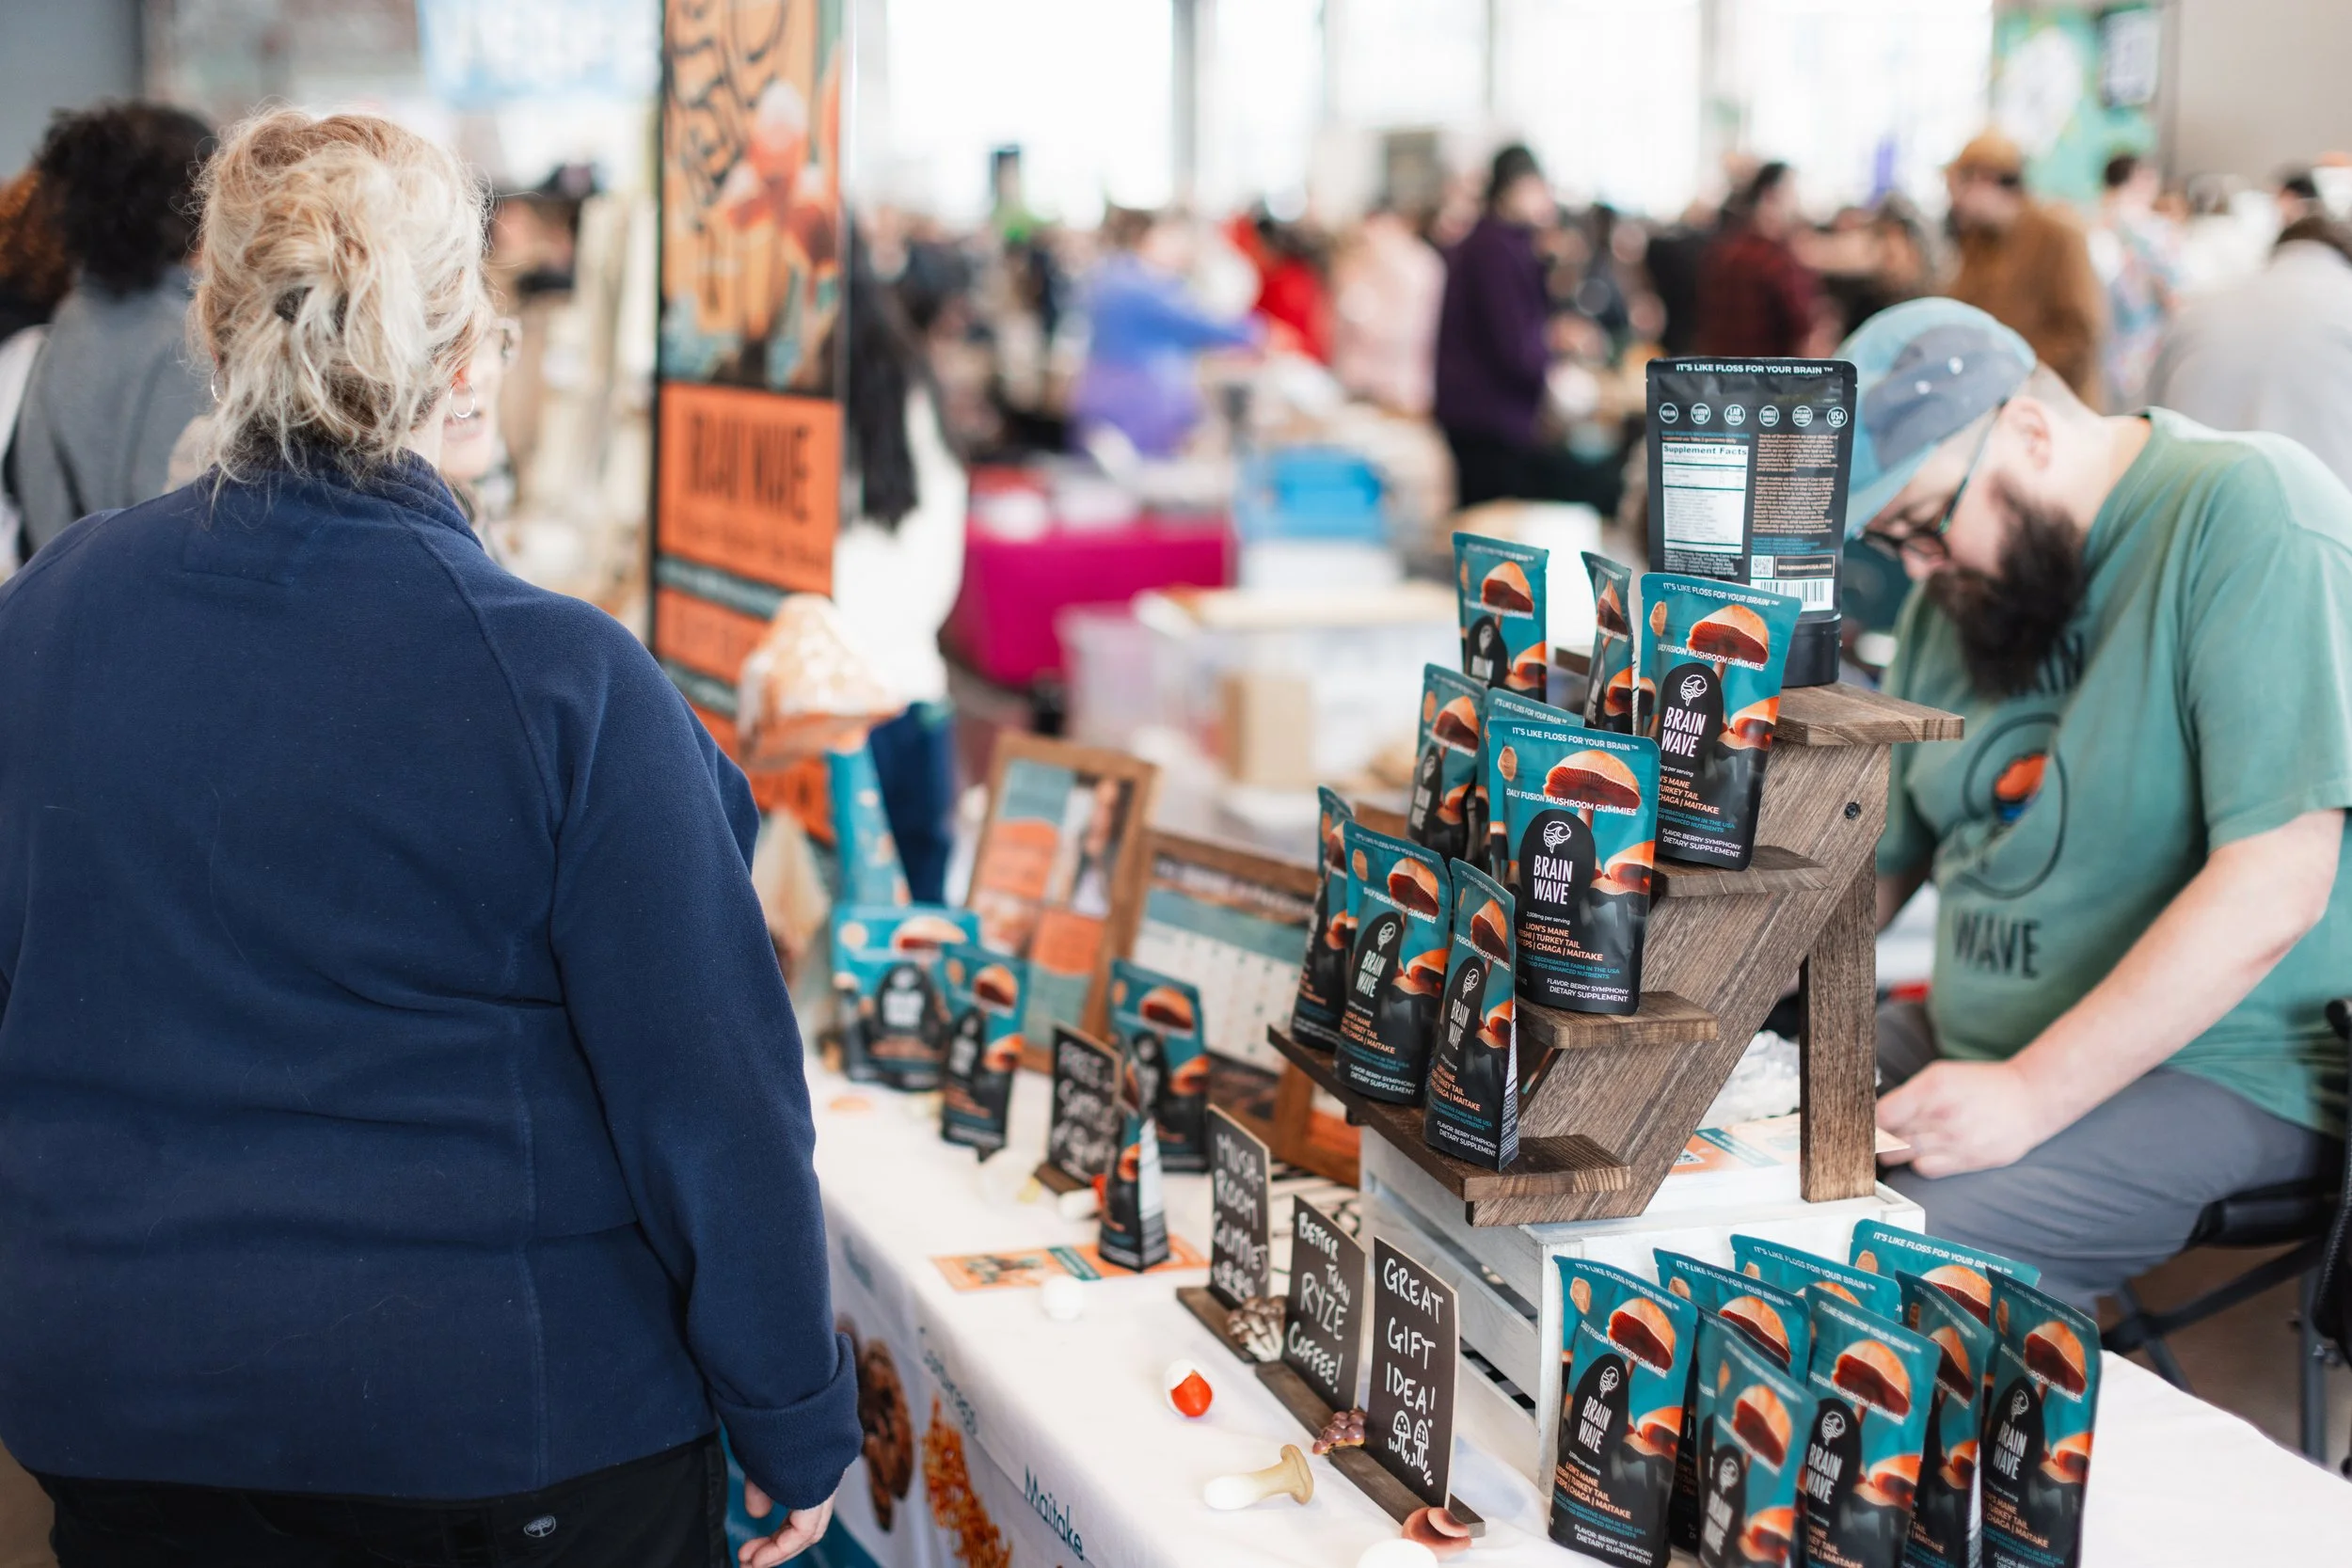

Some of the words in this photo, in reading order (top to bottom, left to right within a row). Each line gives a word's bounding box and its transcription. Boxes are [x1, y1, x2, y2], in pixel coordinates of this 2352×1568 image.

[1716, 364, 1744, 372] FLOSS
[1766, 365, 1790, 373] YOUR
[1794, 366, 1822, 374] BRAIN
[1831, 412, 1844, 420] USA
[1663, 445, 1716, 454] Supplement
[1677, 584, 1692, 593] LIKE
[1692, 588, 1712, 597] FLOSS
[1727, 594, 1746, 602] YOUR
[1746, 595, 1771, 607] BRAIN
[1688, 649, 1727, 664] MUSHROOM
[1727, 657, 1765, 672] GUMMIES
[1663, 706, 1707, 735] BRAIN
[1512, 727, 1525, 736] IT'S
[1527, 729, 1542, 738] LIKE
[1544, 732, 1566, 742] FLOSS
[1568, 736, 1583, 744] FOR
[1584, 738, 1605, 748] YOUR
[1607, 741, 1630, 751] BRAIN
[1661, 729, 1699, 757] WAVE
[1669, 775, 1690, 789] MANE
[1677, 768, 1693, 778] serving
[1506, 788, 1521, 799] DAILY
[1520, 790, 1545, 802] FUSION
[1546, 795, 1594, 811] MUSHROOM
[1596, 804, 1637, 816] GUMMIES
[1684, 789, 1699, 800] TAIL
[1684, 800, 1720, 815] MAITAKE
[1663, 836, 1688, 847] DIETARY
[1690, 843, 1740, 858] SUPPLEMENT
[1682, 832, 1704, 842] BERRY
[1705, 837, 1741, 849] SYMPHONY
[1534, 854, 1573, 882] BRAIN
[1534, 878, 1569, 905] WAVE
[1407, 907, 1437, 924] GUMMIES
[1526, 923, 1547, 933] LION'S
[1548, 927, 1569, 937] MANE
[1536, 934, 1564, 944] TURKEY
[1565, 940, 1580, 948] TAIL
[1537, 942, 1562, 954] CHAGA
[1567, 949, 1603, 961] MAITAKE
[1952, 909, 2042, 980] WAVE
[1360, 949, 1387, 977] BRAIN
[1356, 971, 1378, 998] WAVE
[1549, 986, 1576, 996] DIETARY
[1577, 991, 1628, 1002] SUPPLEMENT
[1570, 982, 1590, 990] BERRY
[1592, 986, 1629, 994] SYMPHONY
[1451, 998, 1470, 1029] BRAIN
[1367, 1038, 1396, 1054] MAITAKE
[1454, 1095, 1481, 1112] MAITAKE
[1439, 1130, 1459, 1143] DIETARY
[1460, 1139, 1496, 1157] SUPPLEMENT
[1454, 1128, 1470, 1139] BERRY
[1470, 1134, 1497, 1149] SYMPHONY
[1873, 1231, 1888, 1242] IT'S
[1888, 1235, 1907, 1247] LIKE
[1906, 1241, 1931, 1254] FLOSS
[1932, 1248, 1949, 1259] FOR
[1951, 1253, 1974, 1266] YOUR
[1754, 1245, 1768, 1255] IT'S
[1769, 1250, 1784, 1260] LIKE
[1785, 1255, 1805, 1269] FLOSS
[1806, 1262, 1821, 1275] FOR
[1821, 1268, 1842, 1281] YOUR
[1843, 1276, 1867, 1291] BRAIN
[1383, 1258, 1444, 1324] GREAT
[1575, 1262, 1589, 1271] IT'S
[1589, 1265, 1605, 1277] LIKE
[1606, 1271, 1626, 1284] FLOSS
[1626, 1278, 1637, 1291] FOR
[1637, 1284, 1655, 1298] YOUR
[1655, 1291, 1673, 1307] BRAIN
[1676, 1259, 1690, 1270] IT'S
[1690, 1264, 1706, 1275] LIKE
[1708, 1270, 1728, 1282] FLOSS
[1728, 1278, 1742, 1289] FOR
[1743, 1282, 1762, 1294] YOUR
[1763, 1291, 1785, 1307] BRAIN
[1300, 1272, 1347, 1341] RYZE
[1387, 1317, 1436, 1370] GIFT
[1288, 1321, 1343, 1394] COFFEE!
[1385, 1362, 1436, 1428] IDEA!
[1581, 1395, 1612, 1432] BRAIN
[1578, 1419, 1604, 1454] WAVE
[1996, 1419, 2028, 1458] BRAIN
[1808, 1443, 1843, 1481] BRAIN
[1993, 1444, 2021, 1481] WAVE
[1571, 1476, 1593, 1493] TURKEY
[1594, 1488, 1610, 1502] TAIL
[1580, 1472, 1598, 1487] MANE
[1805, 1466, 1835, 1506] WAVE
[1025, 1462, 1084, 1561] Maitake
[1569, 1485, 1590, 1504] CHAGA
[1595, 1499, 1631, 1519] MAITAKE
[1576, 1533, 1605, 1549] DIETARY
[1606, 1544, 1652, 1566] SUPPLEMENT
[1598, 1534, 1618, 1545] BERRY
[1618, 1541, 1653, 1558] SYMPHONY
[2015, 1528, 2049, 1548] MAITAKE
